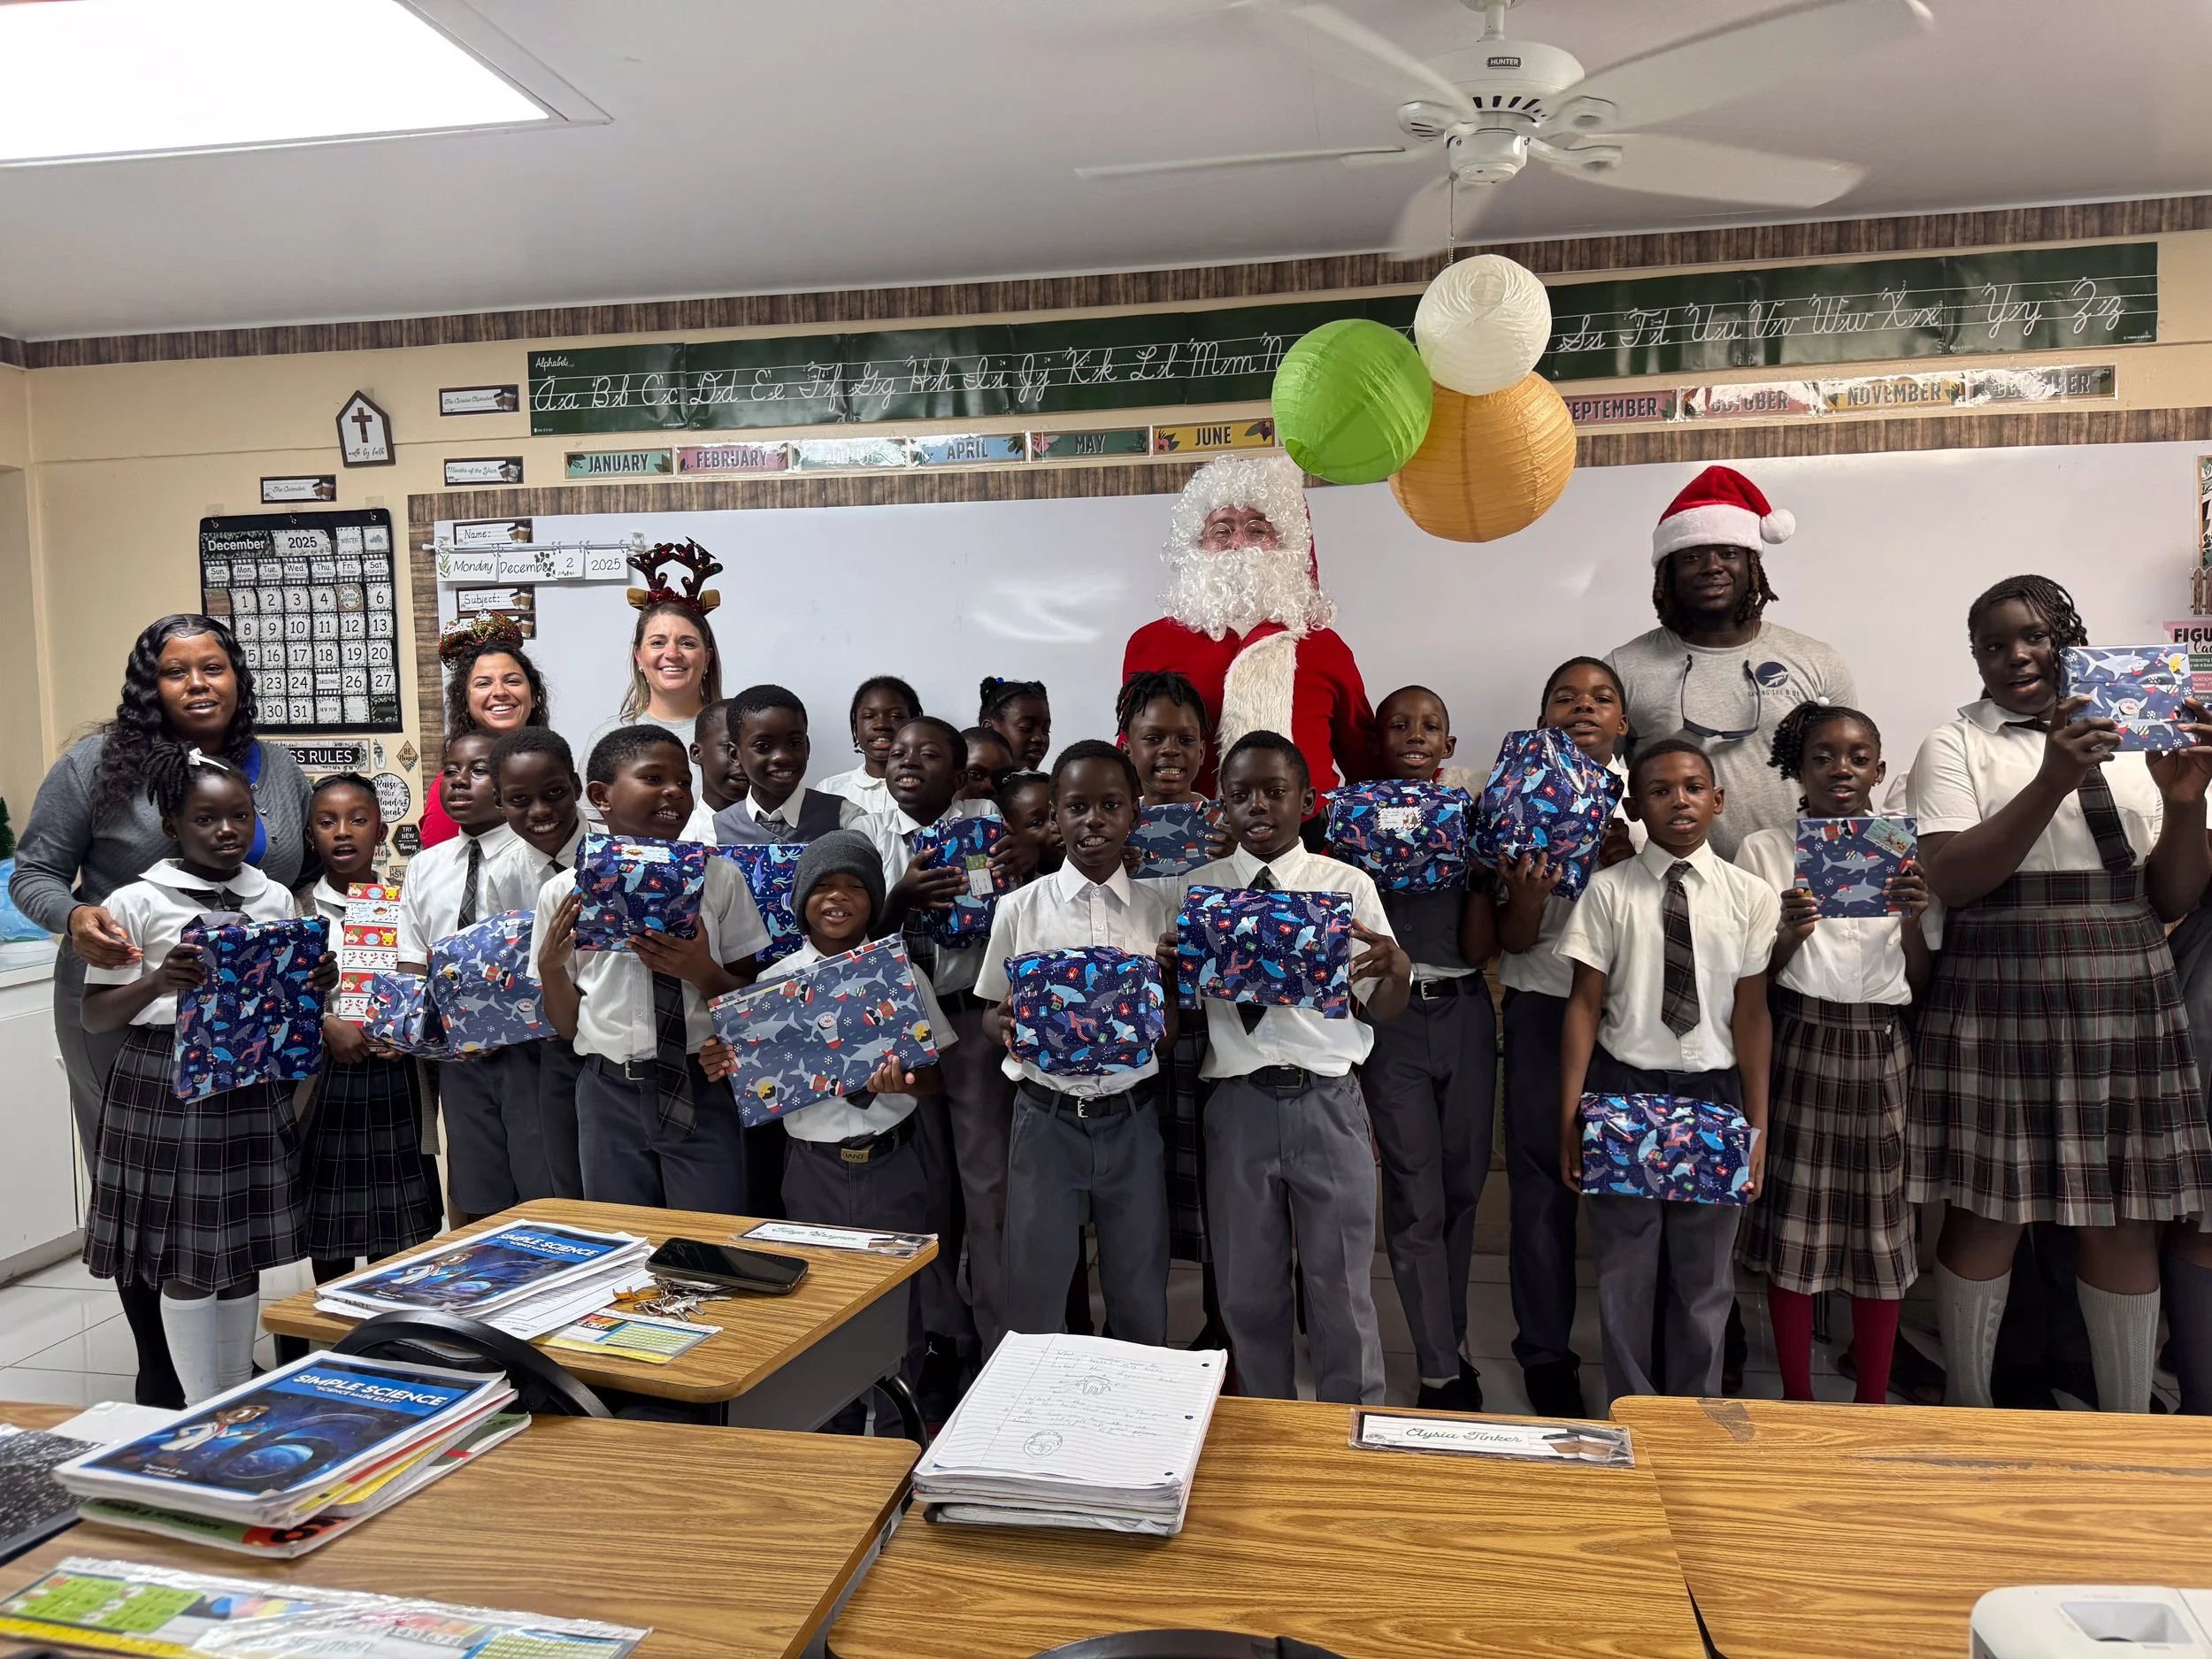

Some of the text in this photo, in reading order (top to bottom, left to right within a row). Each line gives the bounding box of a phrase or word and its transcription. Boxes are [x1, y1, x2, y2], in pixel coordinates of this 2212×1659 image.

[535, 356, 569, 373] Alphabet
[1847, 381, 1942, 407] NOVEMBER
[1566, 397, 1657, 421] EPTEMBER
[1076, 434, 1106, 454] MAY
[1195, 426, 1232, 446] JUNE
[947, 440, 989, 460] APRIL
[588, 454, 649, 472] JANUARY
[696, 449, 767, 469] FEBRUARY
[482, 466, 497, 475] Year
[465, 528, 491, 539] Name:
[208, 536, 317, 552] December 2025
[454, 557, 621, 574] Monday December 2 2025
[242, 591, 384, 608] 1 2 3 4 6
[465, 594, 500, 607] Subject:
[243, 619, 387, 635] 8 9 10 11 12 13
[248, 647, 388, 662] 5 16 17 18 19 20
[266, 677, 281, 689] 23
[291, 677, 307, 689] 24
[345, 675, 362, 687] 26
[375, 674, 391, 687] 27
[267, 705, 307, 718] 30 31
[310, 750, 353, 763] RULES
[377, 780, 397, 789] Raise
[398, 842, 417, 851] Things
[496, 1233, 599, 1256] SIMPLE SCIENCE
[293, 1374, 449, 1407] SIMPLE SCIENCE
[350, 1392, 373, 1402] MADE
[1406, 1426, 1523, 1443] Elysia Tinker
